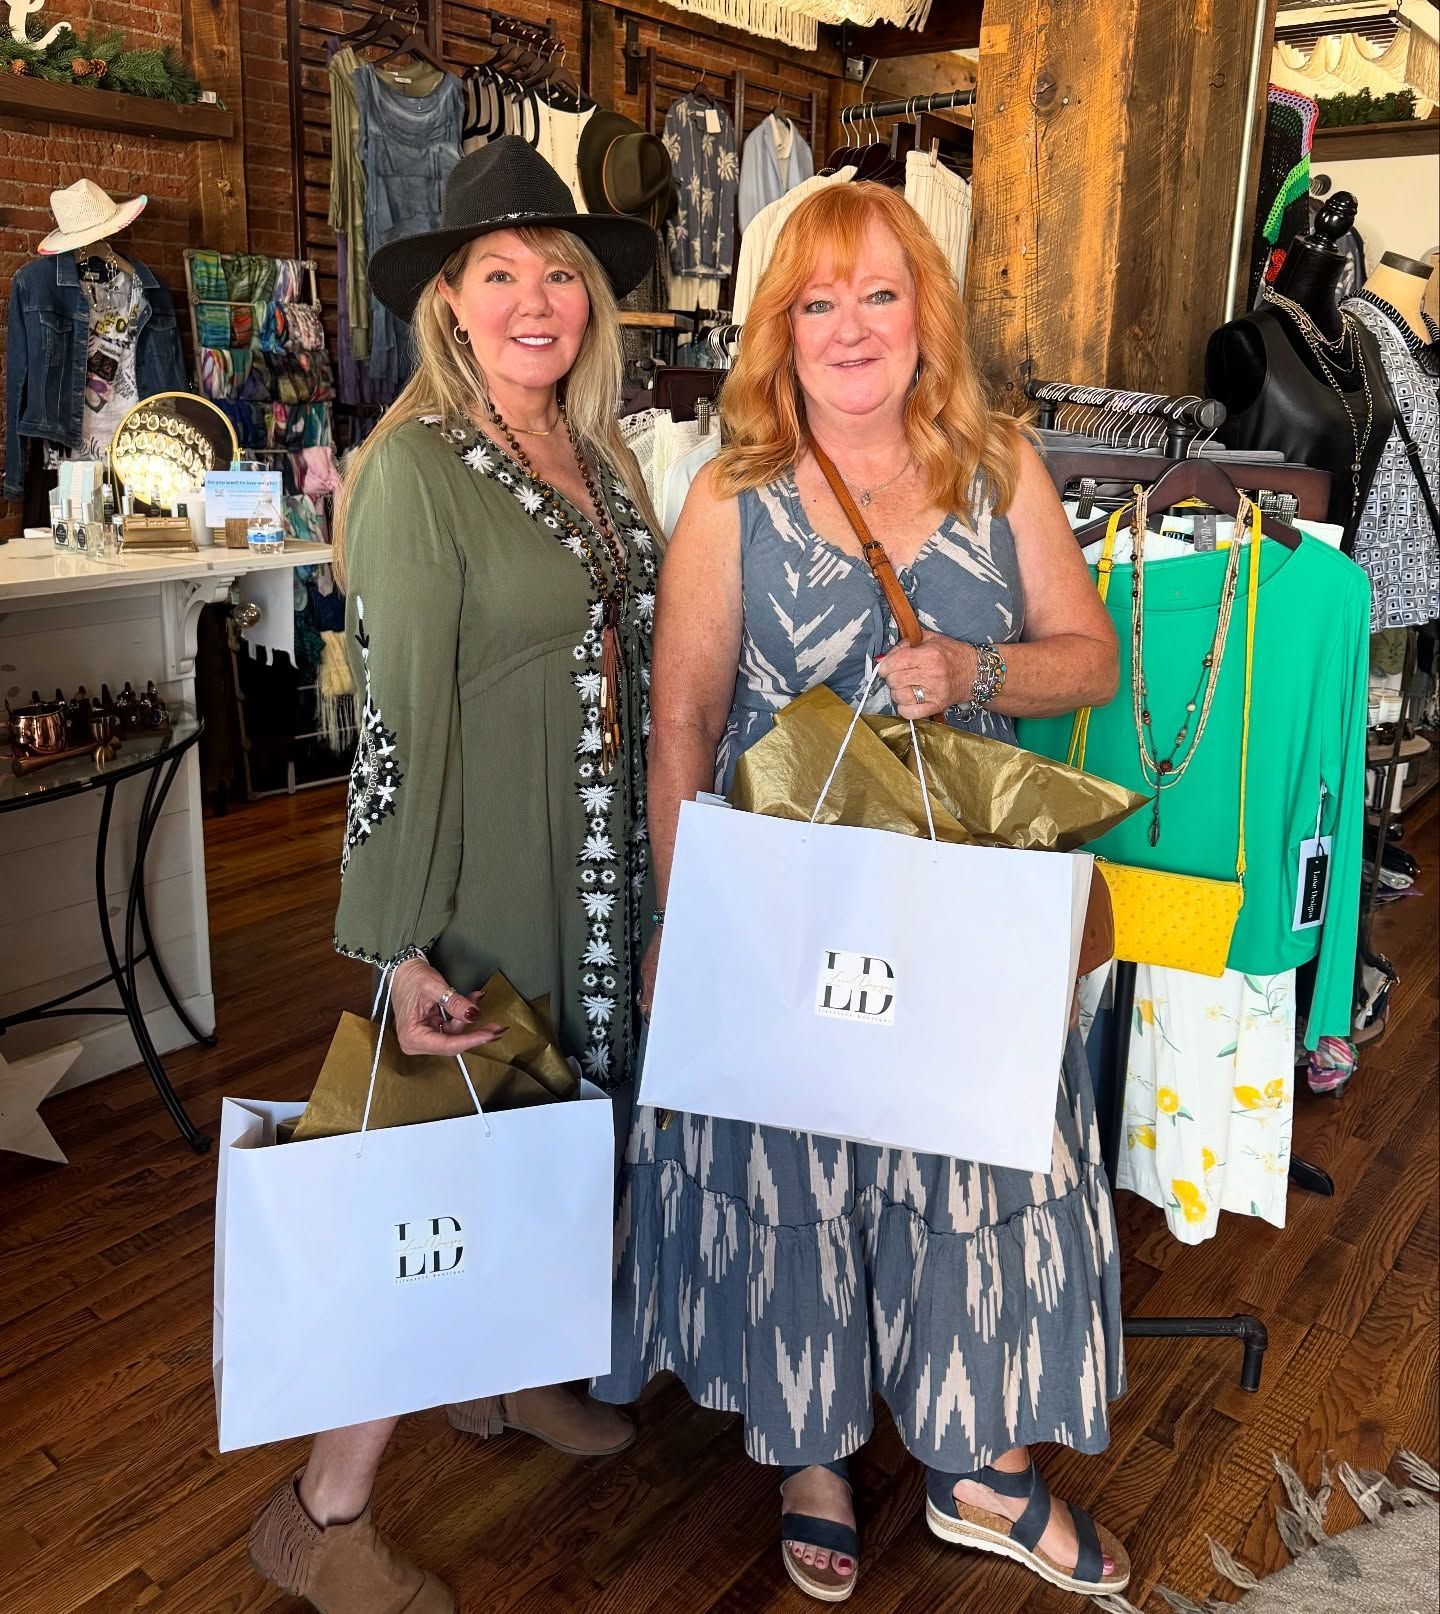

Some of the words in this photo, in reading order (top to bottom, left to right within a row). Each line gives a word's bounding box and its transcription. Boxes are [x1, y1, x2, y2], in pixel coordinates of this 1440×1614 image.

[1307, 890, 1318, 918] Designs
[819, 950, 894, 1015] LD
[394, 1216, 464, 1278] LD
